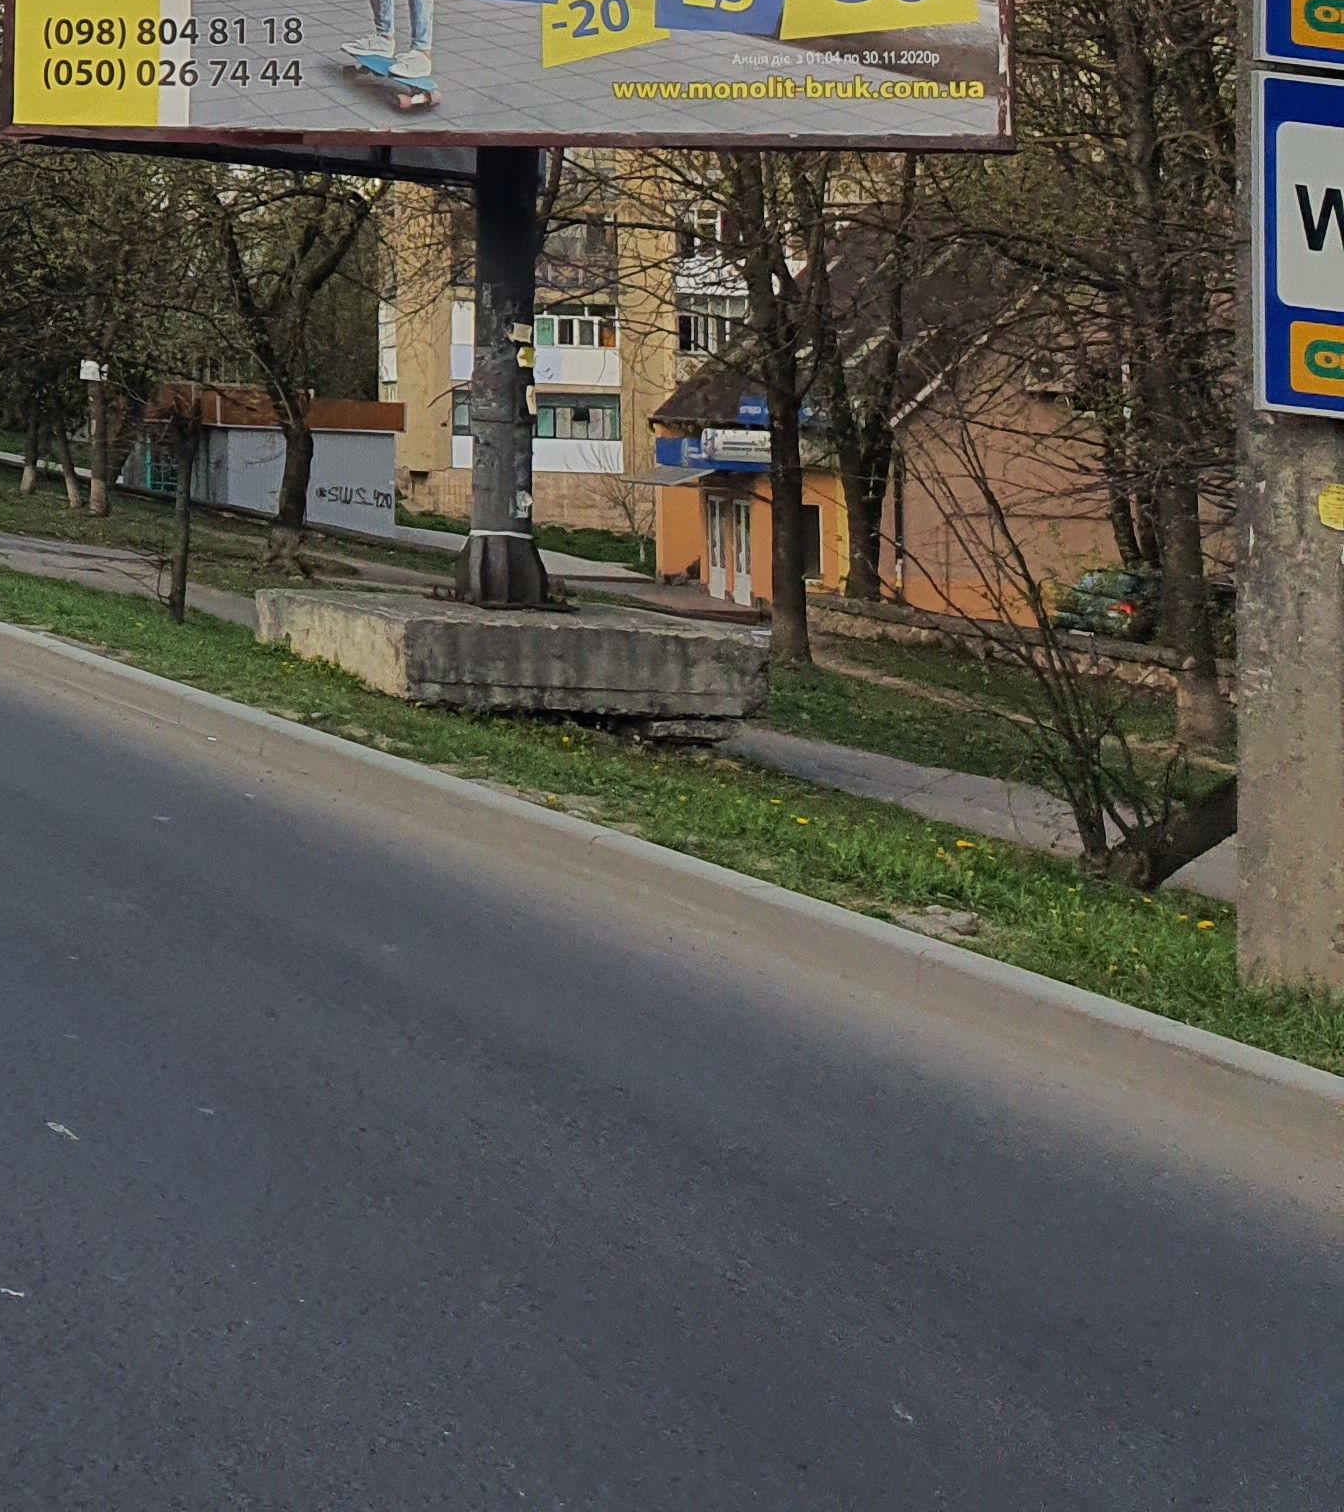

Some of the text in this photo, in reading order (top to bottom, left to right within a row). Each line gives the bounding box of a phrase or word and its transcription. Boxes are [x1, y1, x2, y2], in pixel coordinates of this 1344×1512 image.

[44, 17, 303, 49] (098) 804 81 18
[805, 51, 841, 65] 01.04
[43, 58, 303, 91] (050) 026 74 44
[613, 76, 986, 100] www.monolit-bruk.com.ua
